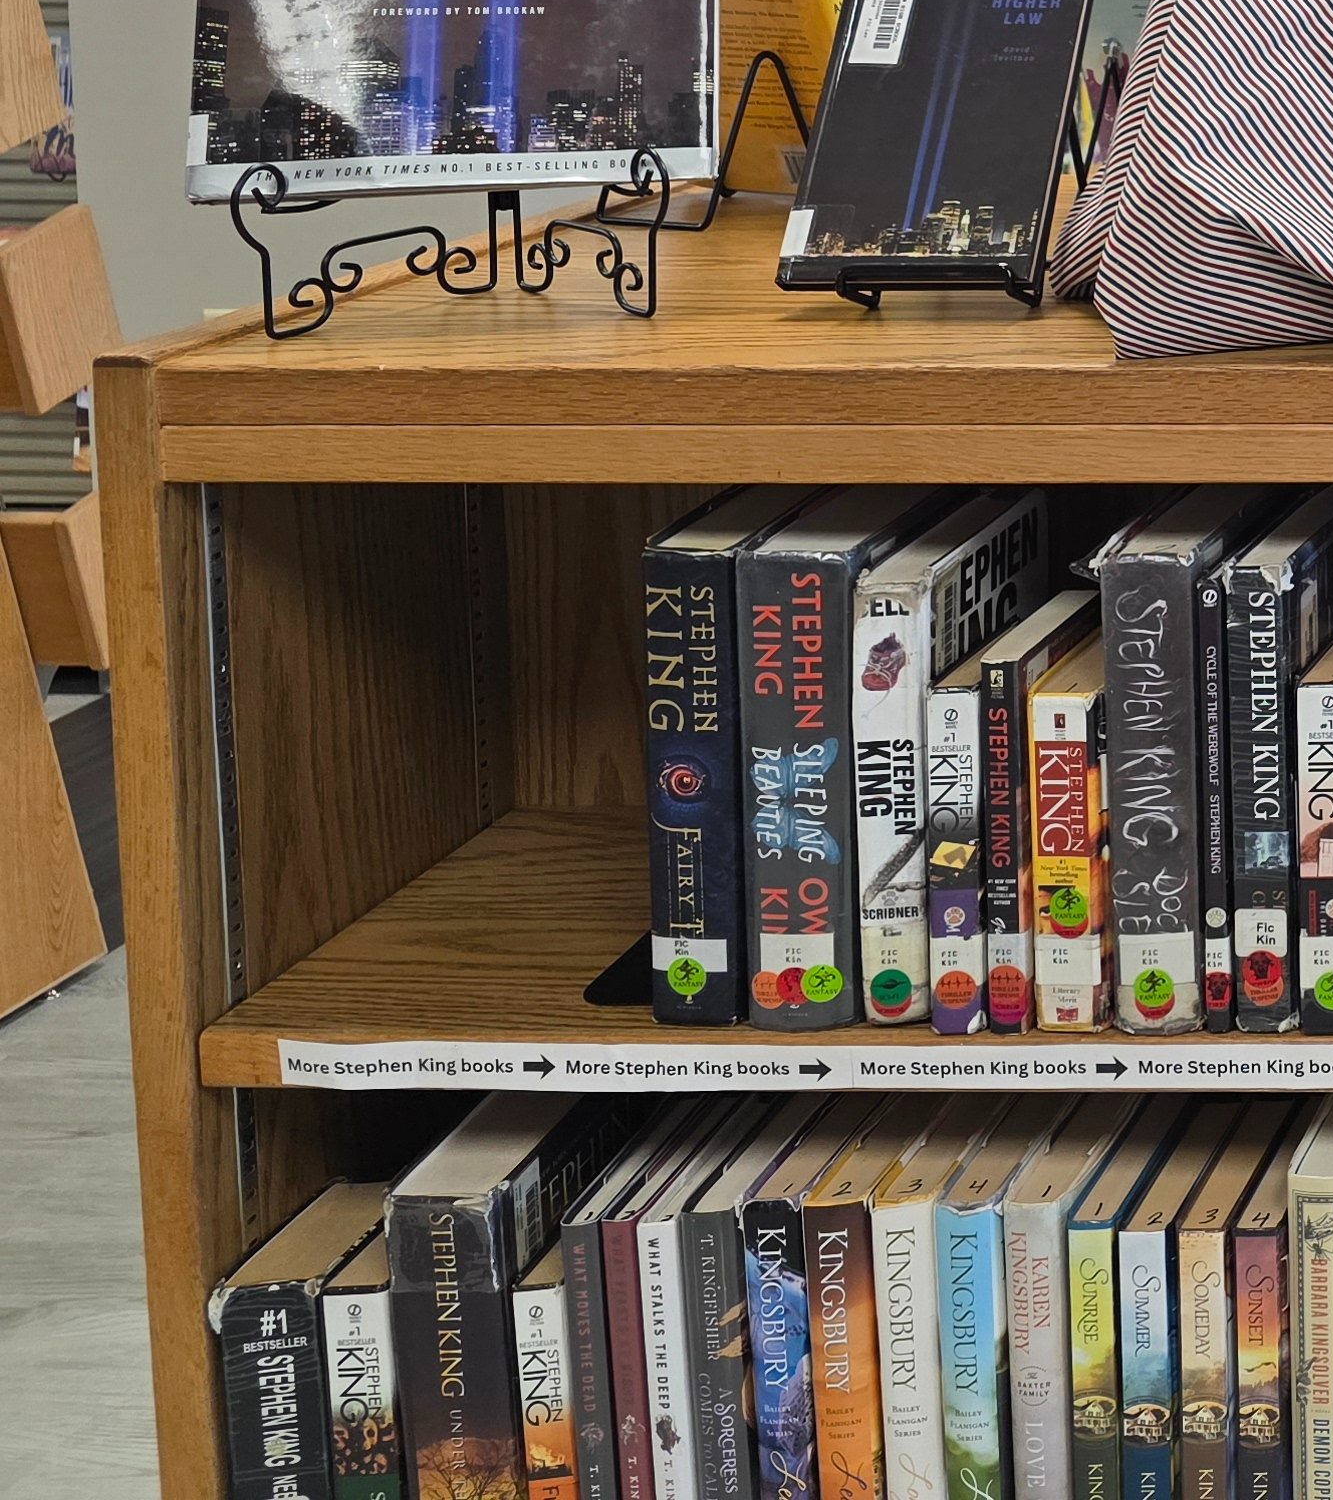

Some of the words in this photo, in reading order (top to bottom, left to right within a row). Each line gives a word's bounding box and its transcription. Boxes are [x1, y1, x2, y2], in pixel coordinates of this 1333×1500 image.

[373, 6, 438, 17] FOREWORD
[446, 6, 461, 16] BY
[468, 6, 490, 16] TOM
[498, 6, 546, 16] BROKAW
[1003, 12, 1043, 26] LAW
[753, 605, 783, 695] KING
[790, 573, 825, 730] STEPHEN
[1247, 591, 1281, 735] STEPHEN
[1251, 749, 1281, 821] KING
[751, 746, 783, 860] BEAUTIES
[793, 742, 828, 863] SLEEPING
[862, 906, 919, 920] SCRIBNER
[673, 940, 689, 949] FIC
[674, 948, 690, 956] Kin
[288, 1057, 330, 1075] More
[334, 1057, 413, 1078] Stephen
[418, 1057, 456, 1077] King
[461, 1057, 514, 1074] books
[260, 1309, 289, 1336] #1
[817, 1227, 850, 1394] KINGSBURY
[243, 1336, 308, 1354] BESTSELLER
